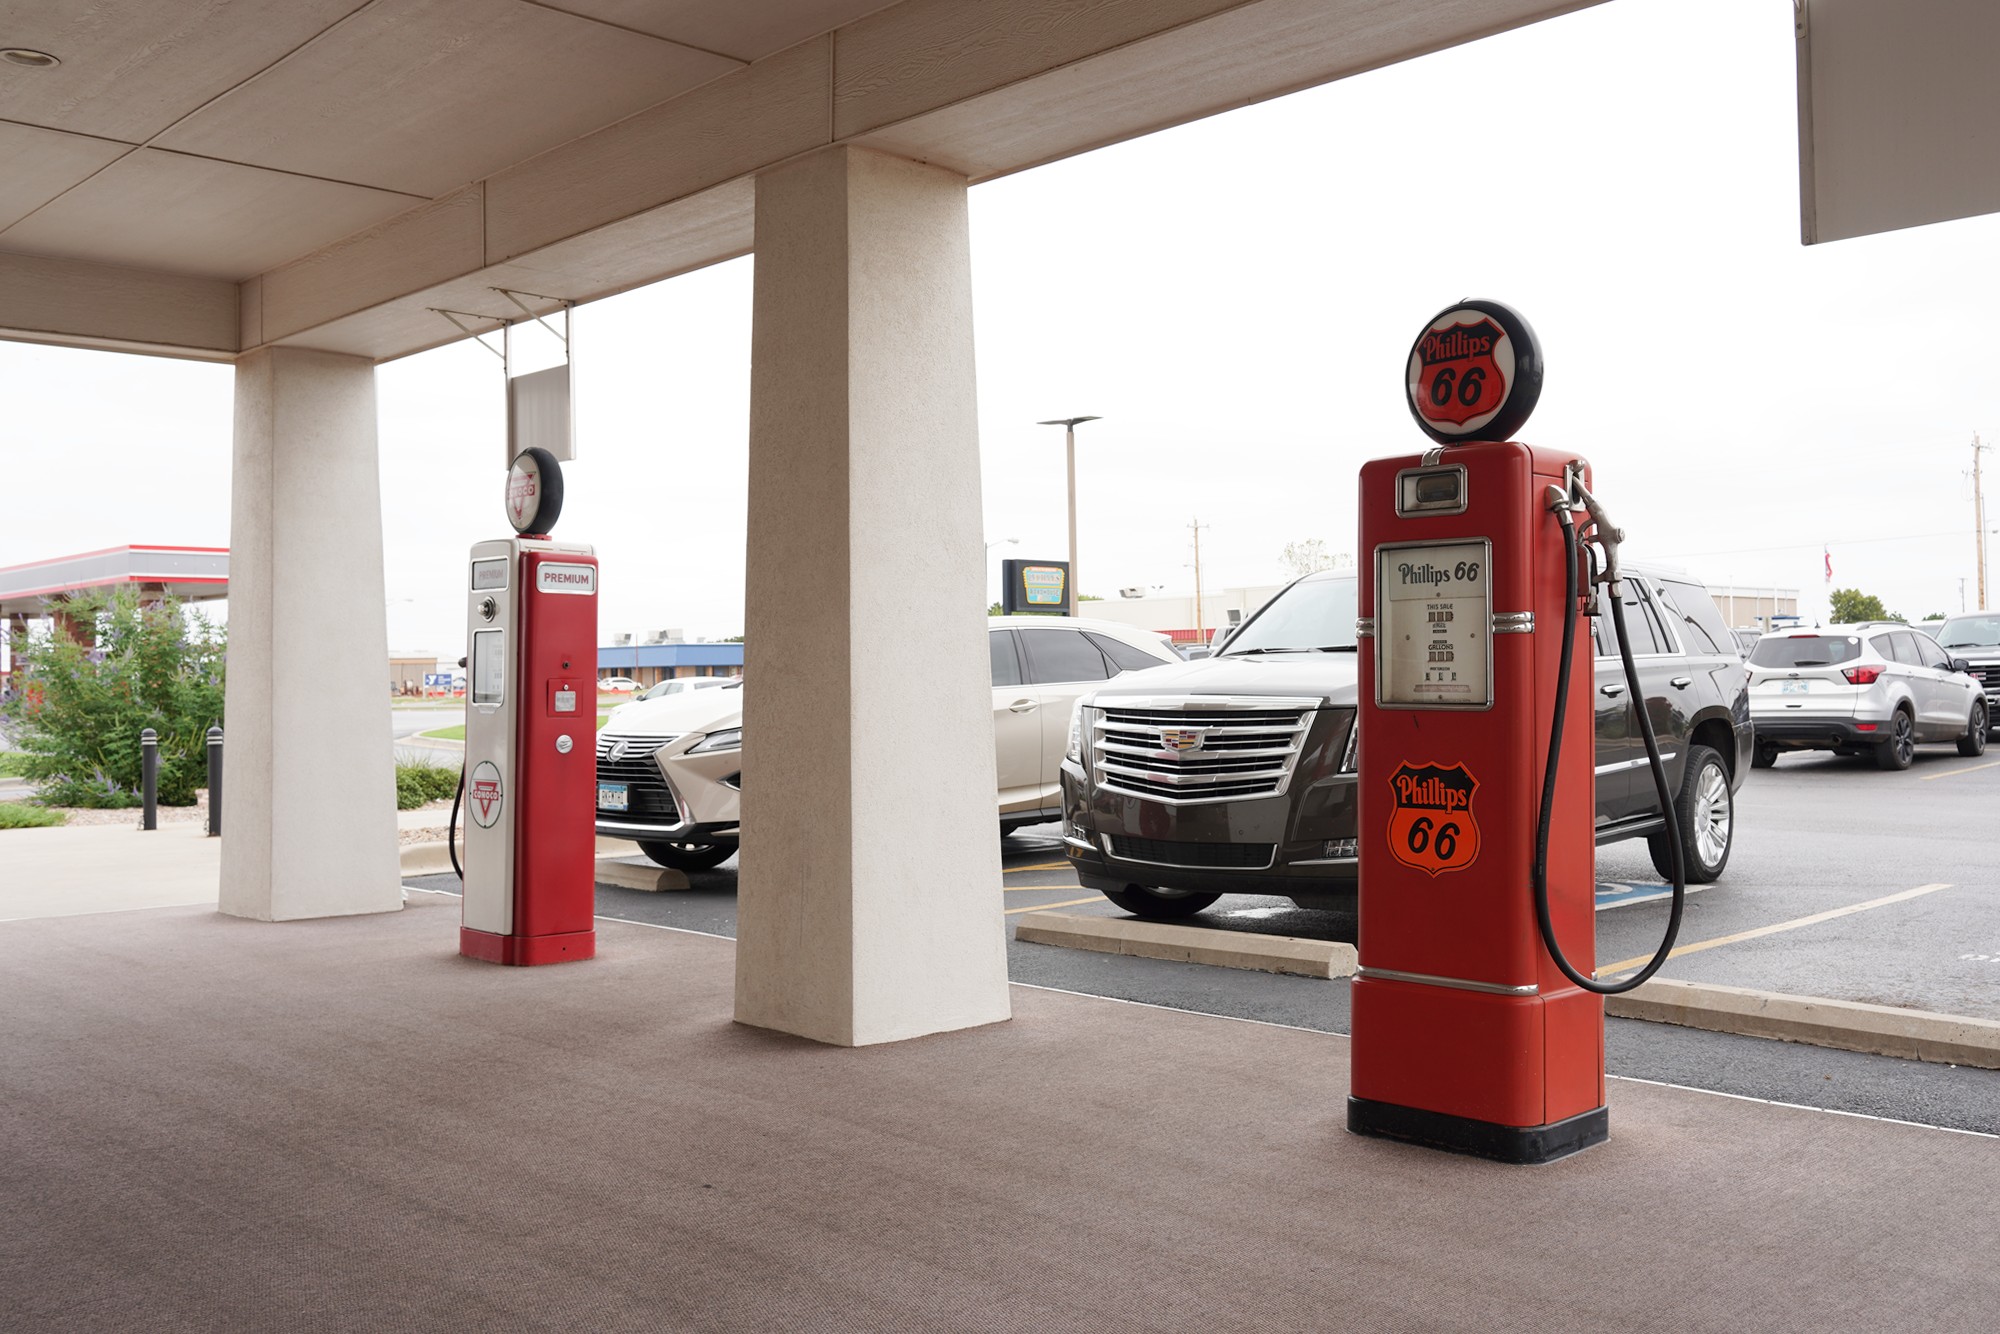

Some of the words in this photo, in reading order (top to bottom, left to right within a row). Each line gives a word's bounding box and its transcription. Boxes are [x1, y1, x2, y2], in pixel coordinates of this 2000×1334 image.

[1424, 331, 1490, 361] Phillips
[1431, 367, 1486, 406] 66
[544, 572, 589, 584] PREMIUM
[1398, 563, 1451, 587] Phillips
[1454, 561, 1479, 582] 66
[474, 791, 498, 800] CONOCO
[1397, 775, 1467, 814] Phillips
[1408, 817, 1461, 860] 66
